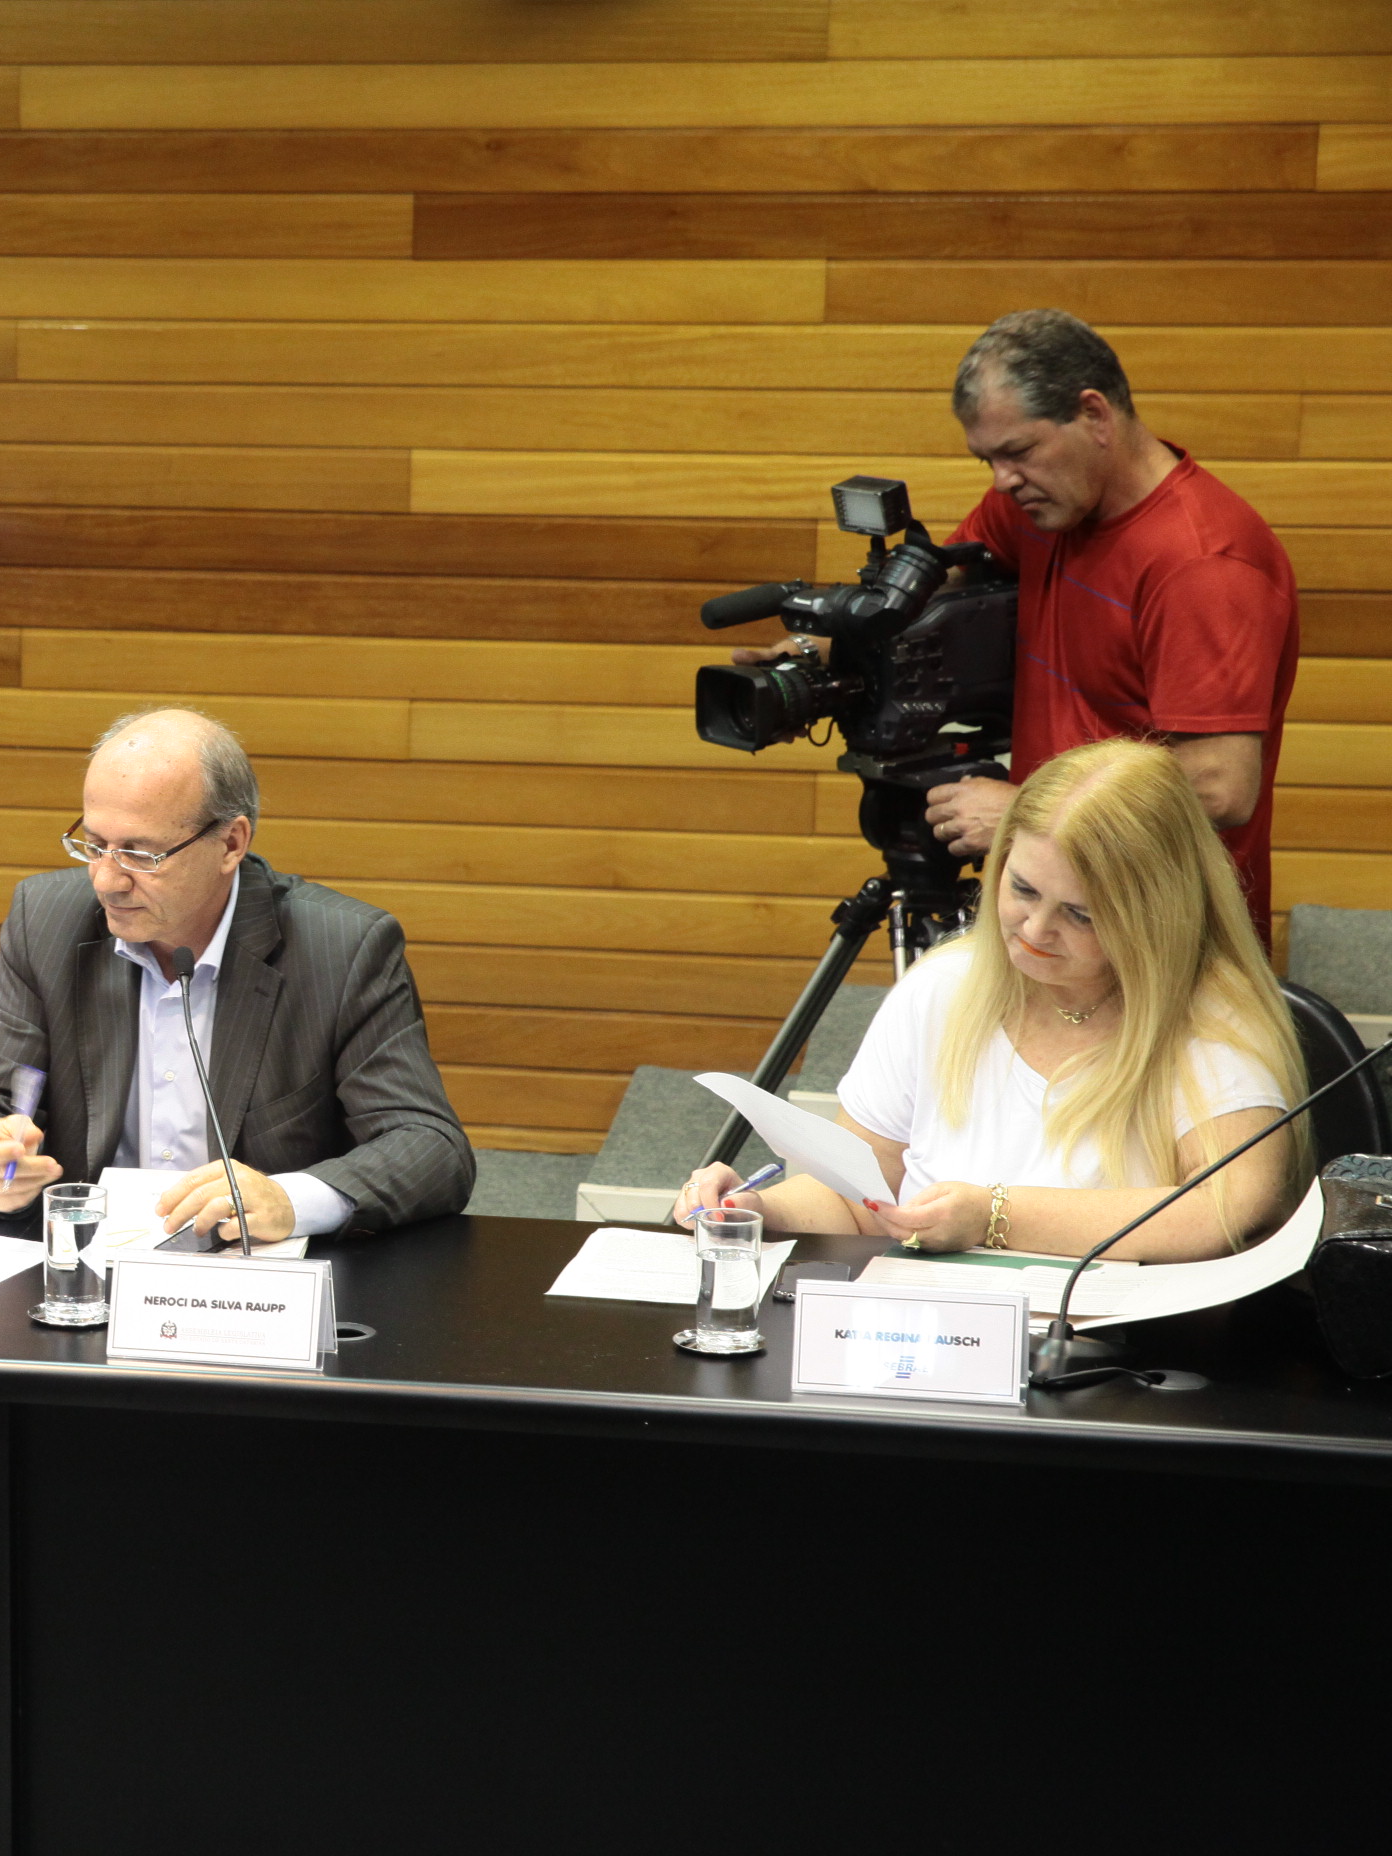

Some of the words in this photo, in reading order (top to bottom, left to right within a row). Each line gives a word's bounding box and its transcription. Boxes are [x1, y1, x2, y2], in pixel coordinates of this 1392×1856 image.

[144, 1295, 188, 1307] NEROCI
[191, 1298, 207, 1308] DA
[211, 1300, 242, 1311] SILVA
[245, 1302, 286, 1313] RAUPP
[834, 1329, 872, 1340] KATA
[927, 1334, 981, 1347] AUSCH
